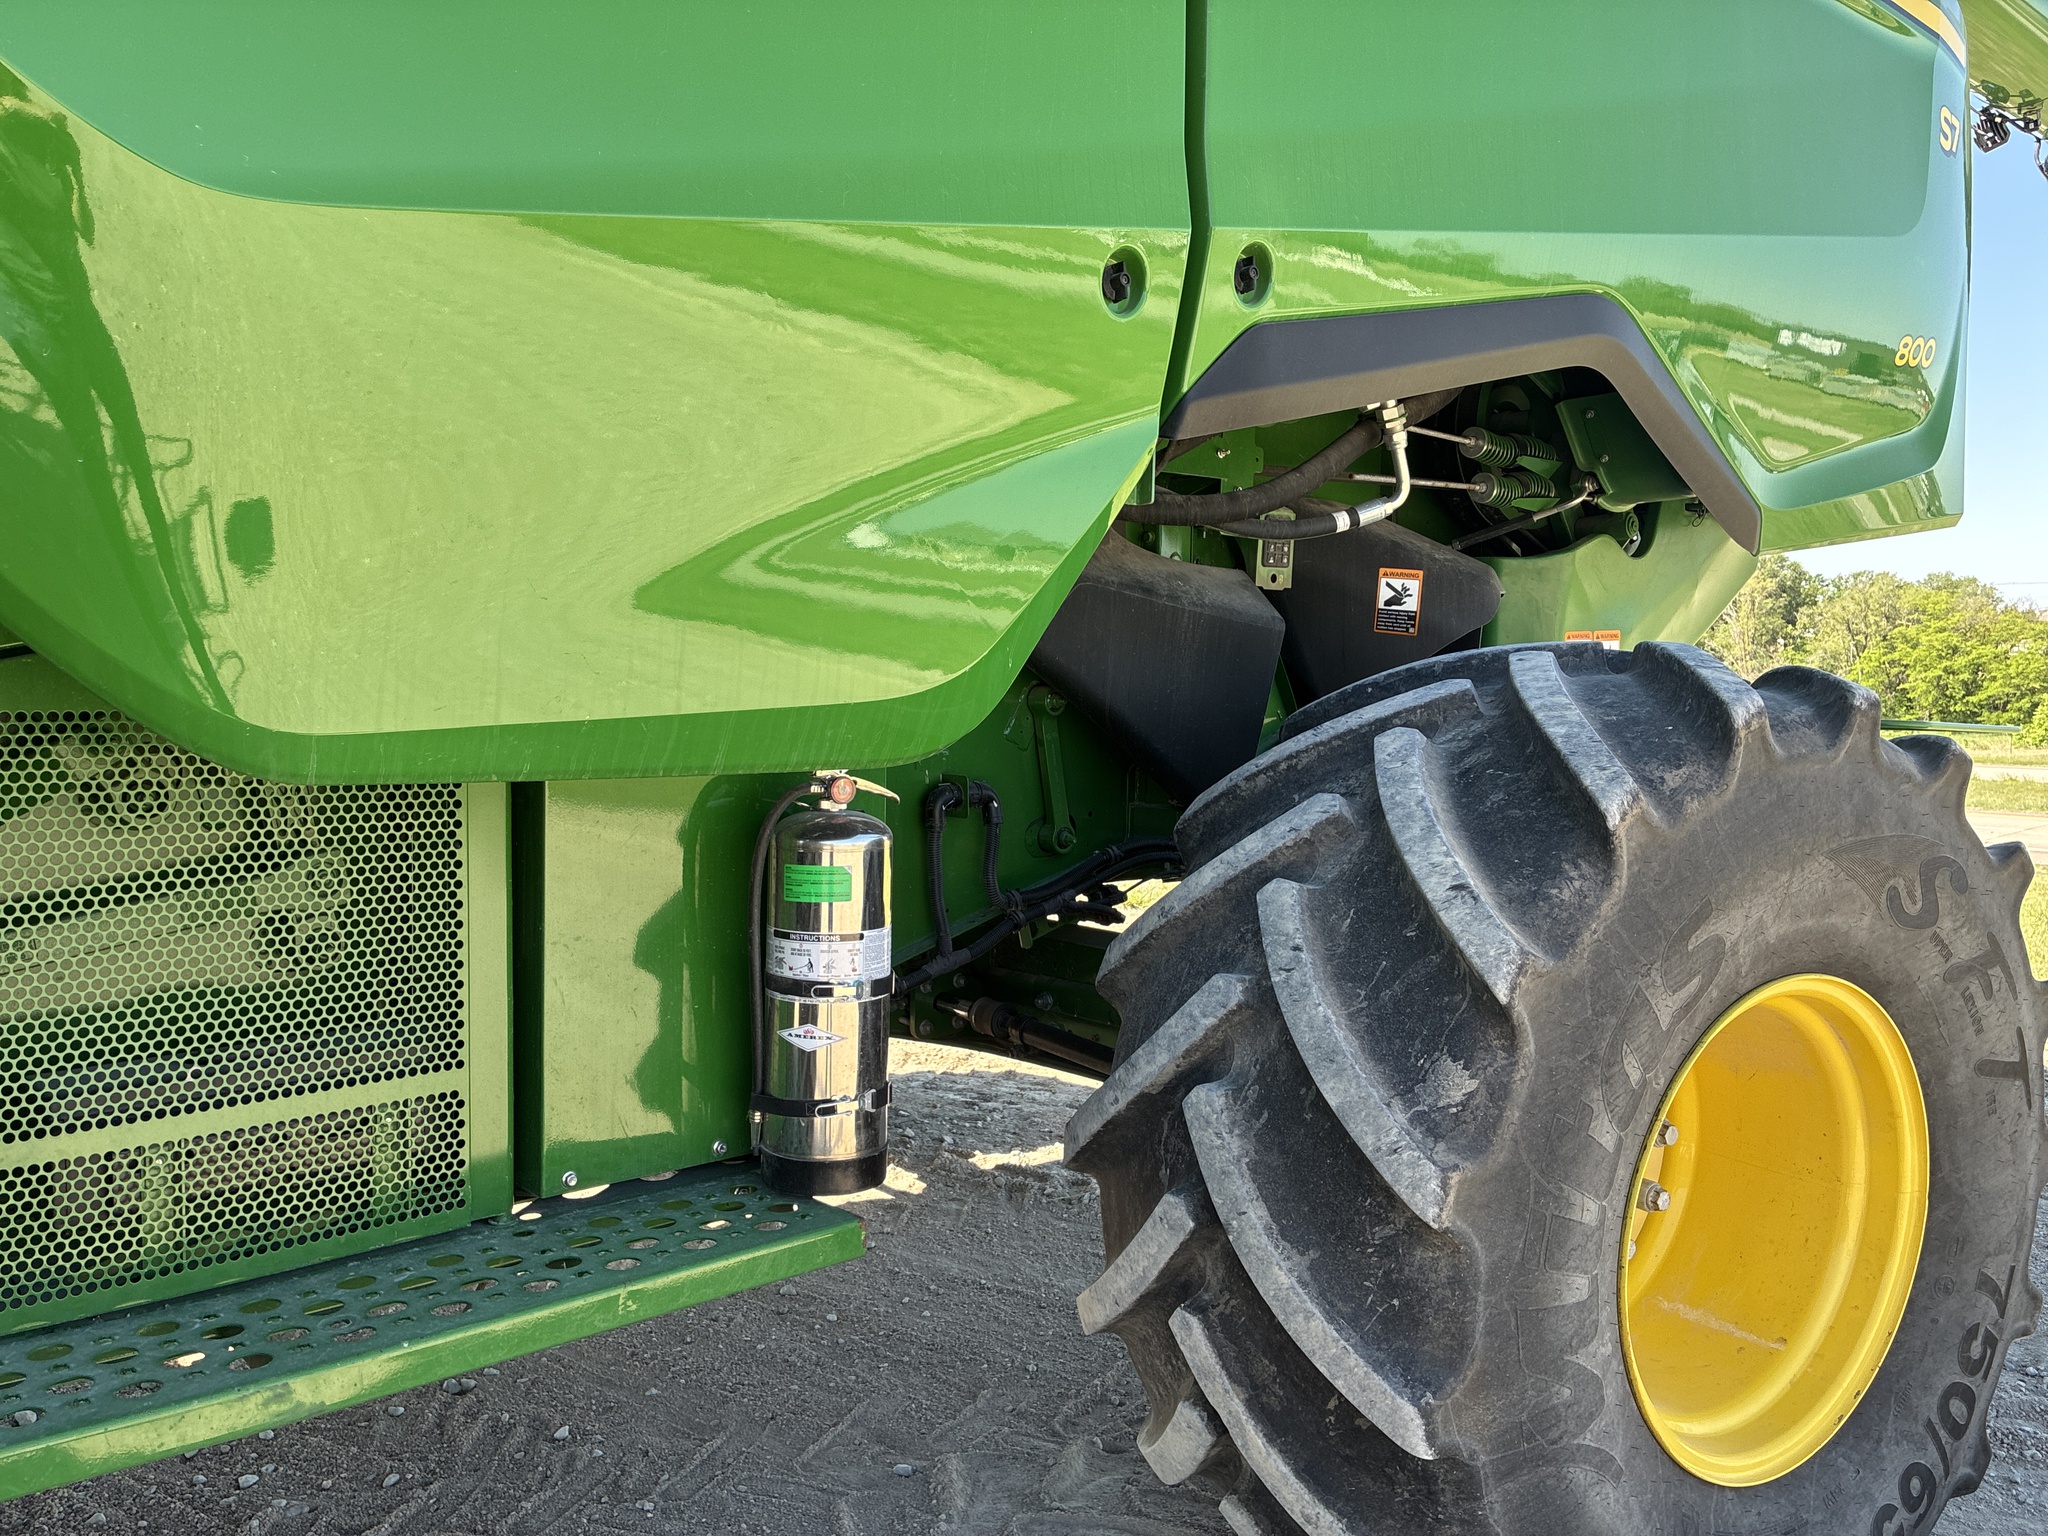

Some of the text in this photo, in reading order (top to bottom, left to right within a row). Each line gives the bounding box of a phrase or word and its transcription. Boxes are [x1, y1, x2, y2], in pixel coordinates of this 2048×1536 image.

[1940, 105, 1960, 158] S7
[1894, 334, 1936, 369] 800
[1389, 571, 1420, 579] WARNING
[789, 932, 841, 942] INSTRUCTIONS
[786, 1032, 834, 1041] AMEREX
